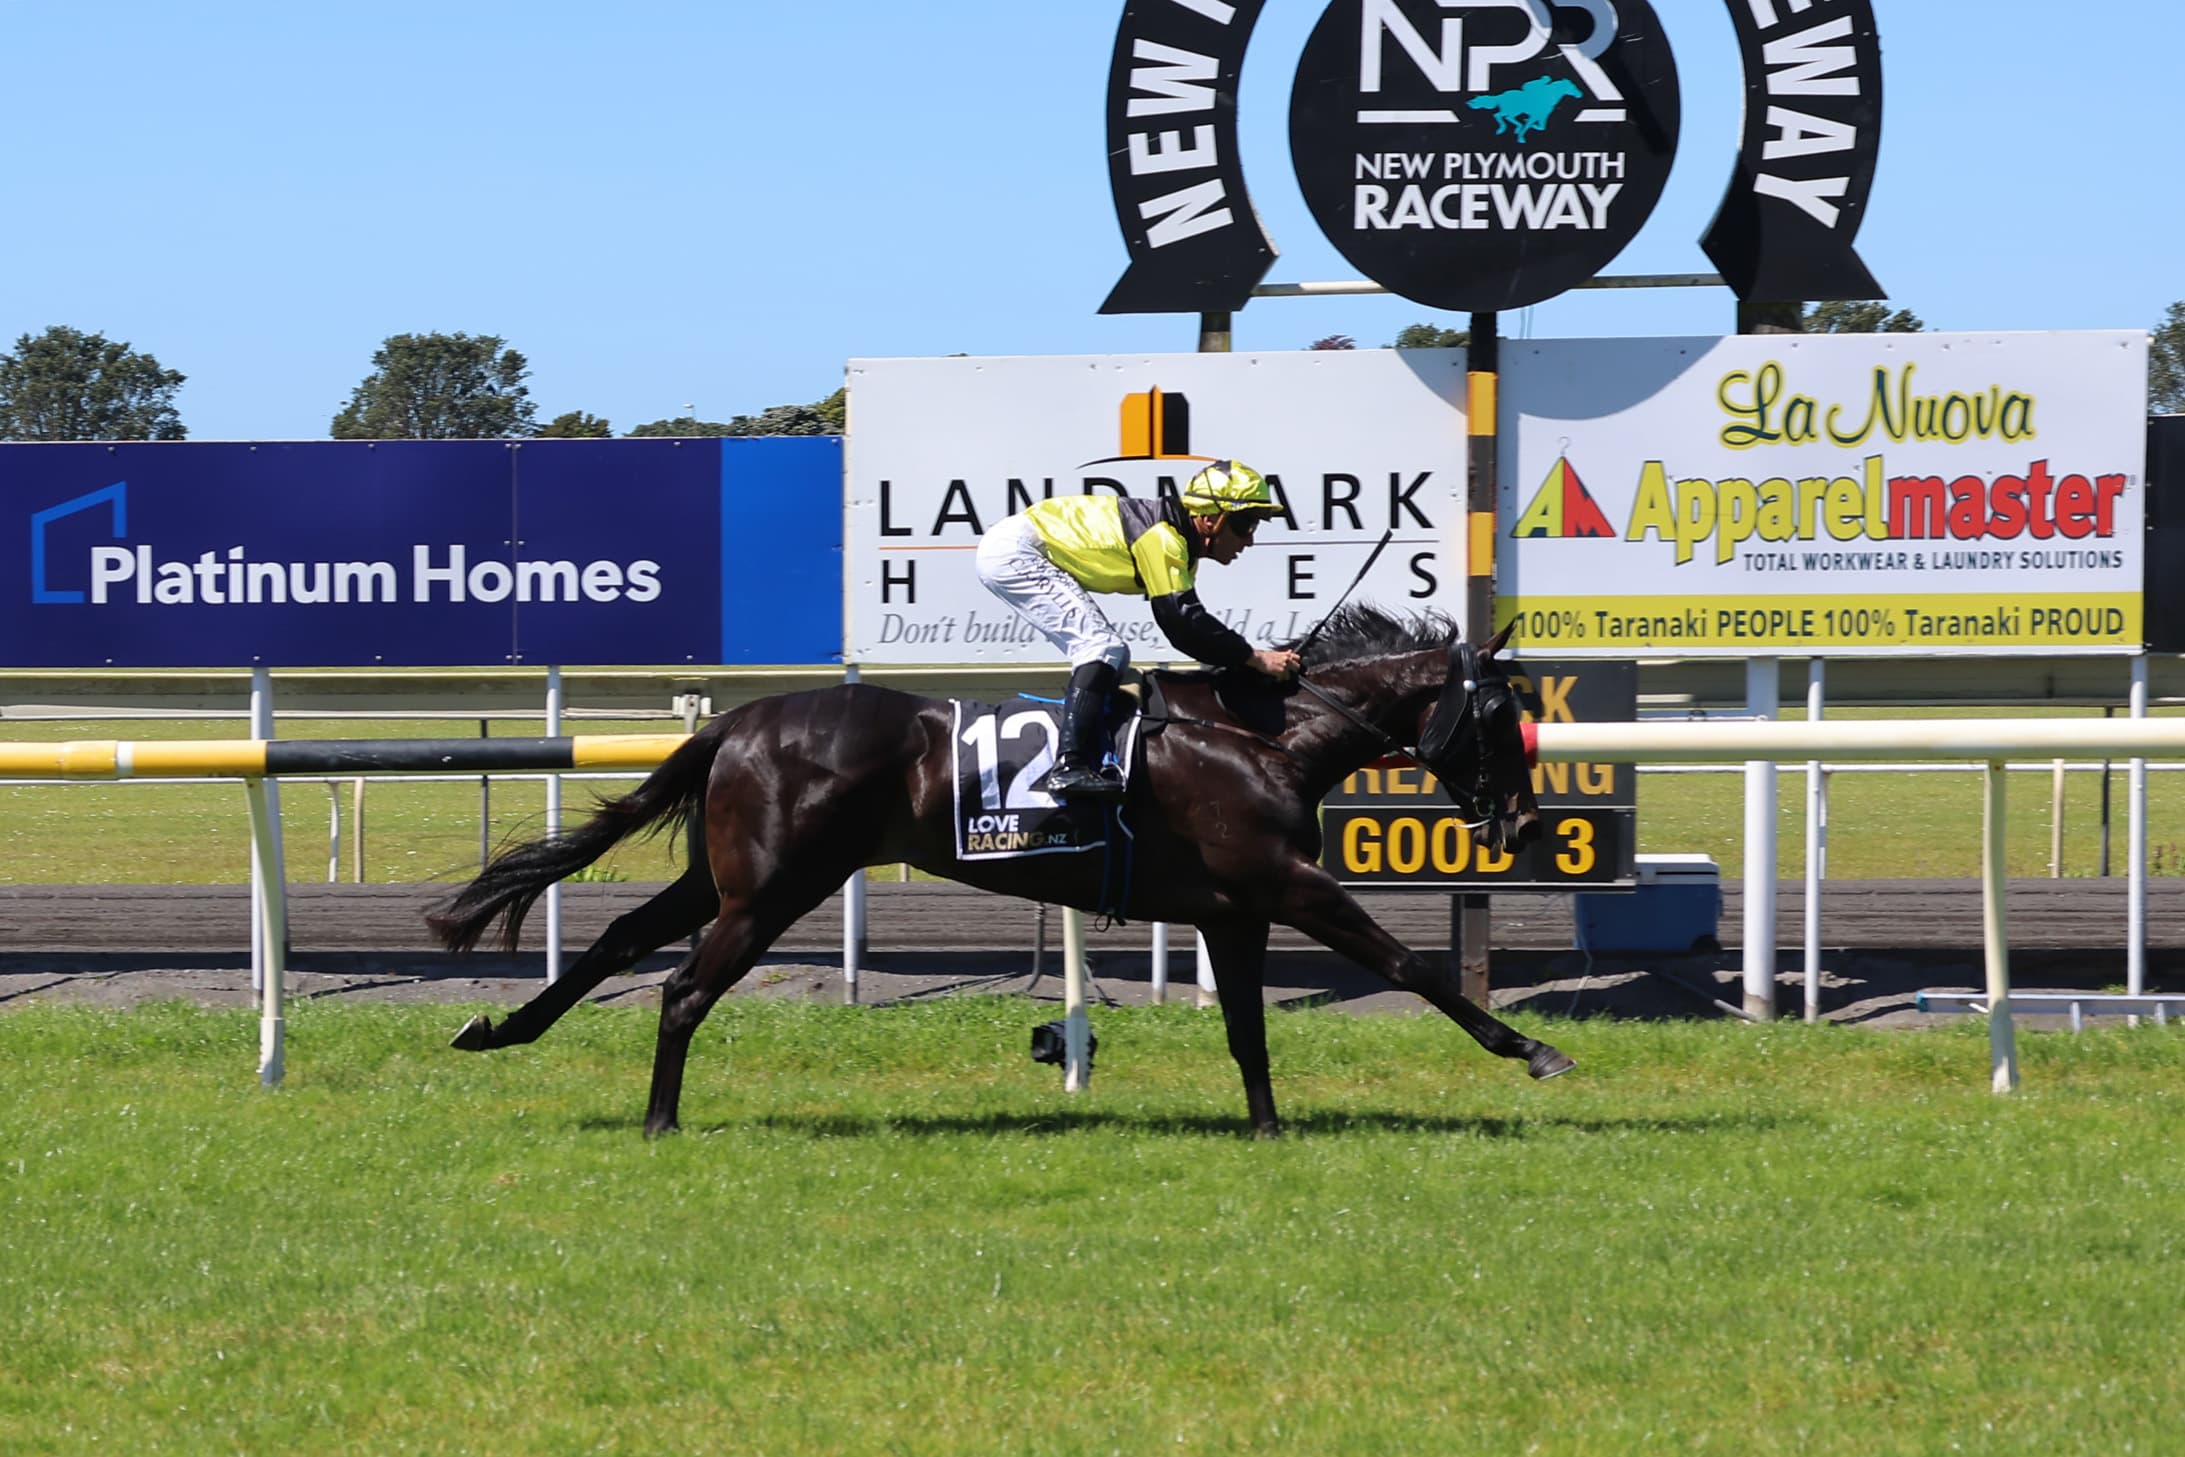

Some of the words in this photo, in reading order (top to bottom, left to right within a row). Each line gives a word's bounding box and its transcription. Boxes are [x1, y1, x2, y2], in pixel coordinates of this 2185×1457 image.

[1359, 0, 1625, 101] NPR
[1126, 38, 1235, 249] NEW
[1355, 152, 1436, 180] NEW
[1444, 151, 1626, 180] PLYMOUTH
[1354, 183, 1625, 230] RACEWAY
[1718, 360, 1818, 448] La
[1825, 361, 2037, 448] Nuova
[1624, 454, 2127, 567] Apparelmaster
[90, 545, 398, 604] Platinum
[412, 544, 663, 603] Homes
[1744, 552, 1798, 571] TOTAL
[1803, 552, 1909, 571] WORKWEAR
[1913, 552, 1926, 570] &
[1932, 551, 2014, 570] LAUNDRY
[2019, 550, 2124, 569] SOLUTIONS
[1517, 610, 1587, 639] 100%
[1595, 607, 1708, 638] Taranaki
[1717, 609, 1815, 637] PEOPLE
[1823, 609, 1896, 637] 100%
[1904, 606, 2020, 637] Taranaki
[2031, 607, 2126, 636] PROUD
[961, 710, 1060, 811] 12
[968, 815, 1020, 833] LOVE
[1555, 817, 1597, 874] 3
